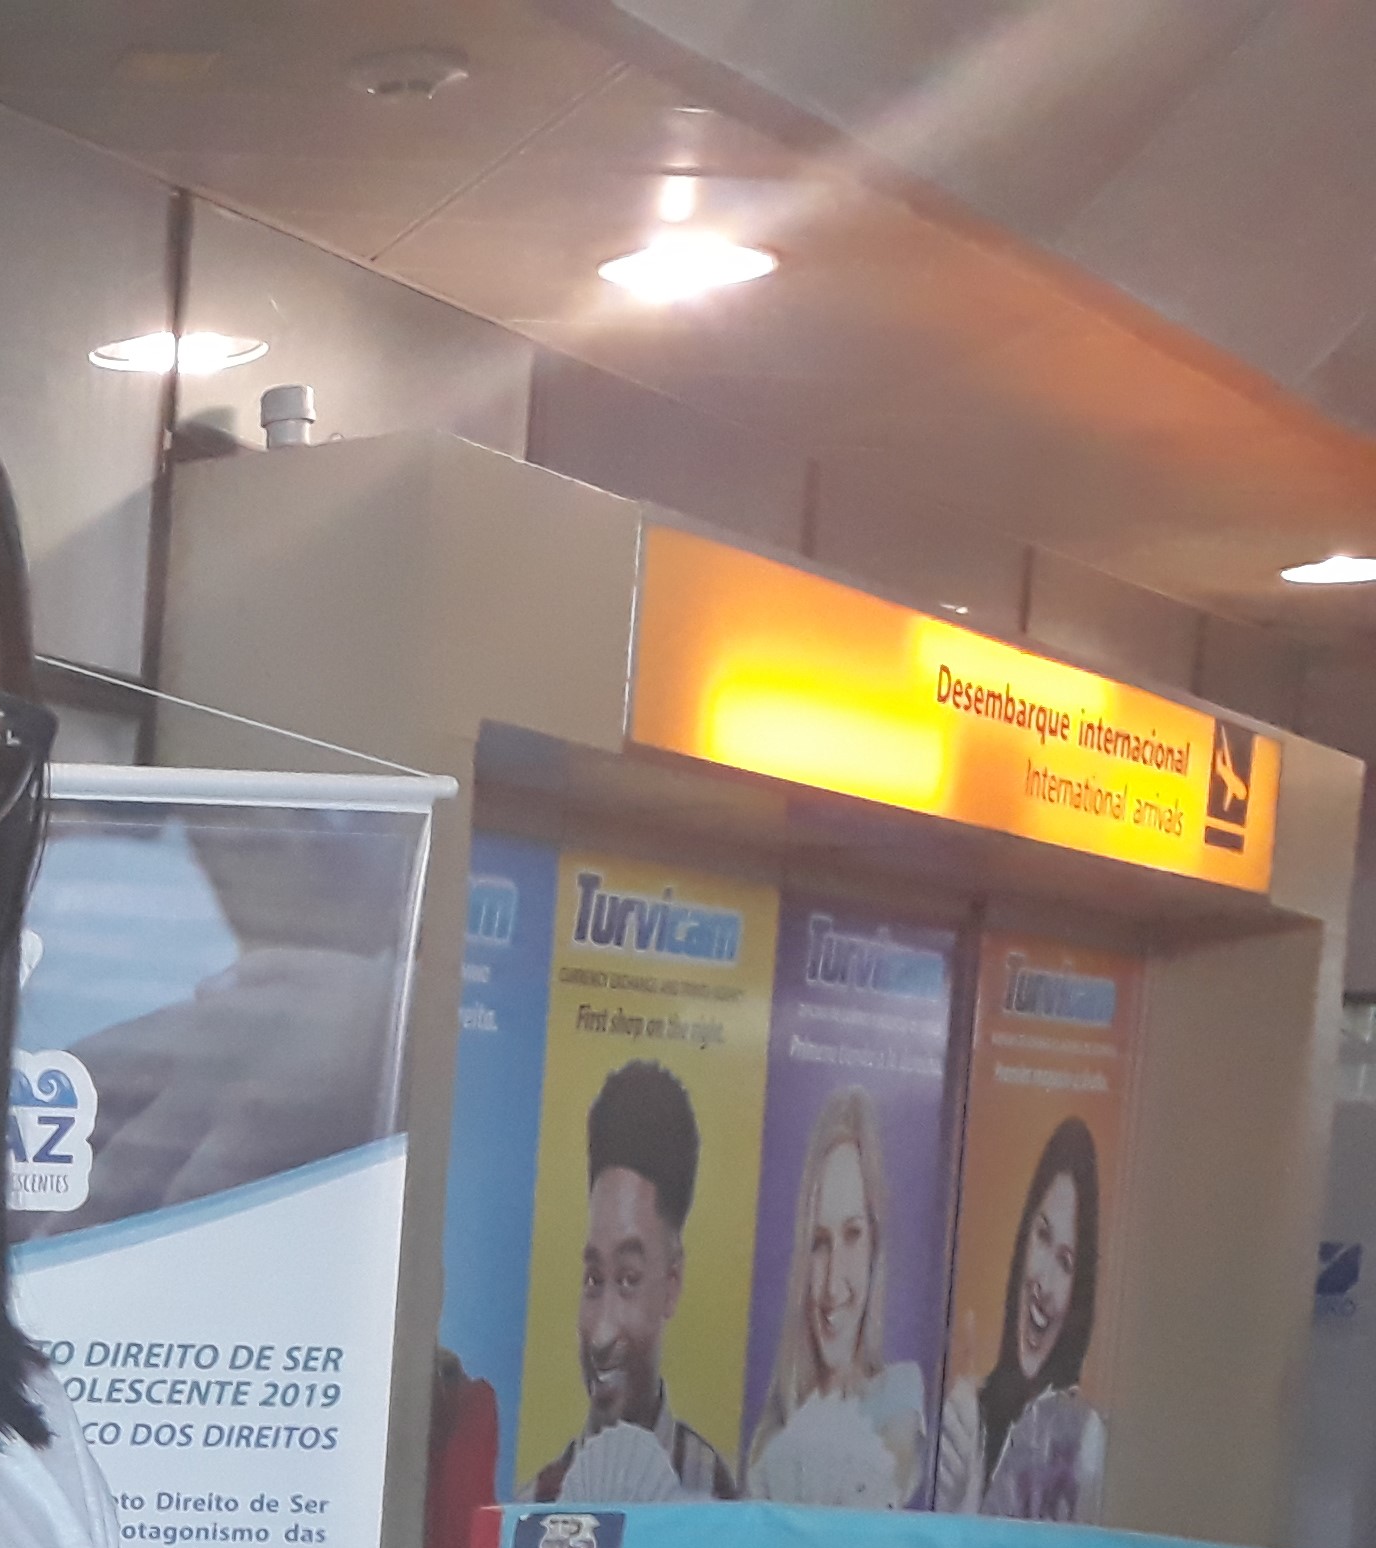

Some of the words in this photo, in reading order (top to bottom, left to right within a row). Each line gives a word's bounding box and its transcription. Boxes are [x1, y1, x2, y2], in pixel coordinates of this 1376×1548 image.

[937, 663, 1070, 745] Desembarque
[1079, 708, 1191, 777] internacional
[1025, 757, 1128, 822] International
[1133, 793, 1185, 838] arrivals
[573, 871, 740, 964] Turvicam
[84, 1341, 219, 1371] DIREITO
[228, 1344, 275, 1372] DE
[282, 1346, 345, 1373] SER
[258, 1381, 342, 1409] 2019
[130, 1423, 194, 1447] DOS
[202, 1424, 339, 1450] DIREITOS
[156, 1492, 239, 1514] Direito
[249, 1493, 279, 1514] de
[289, 1494, 330, 1515] Ser
[284, 1524, 326, 1543] das
